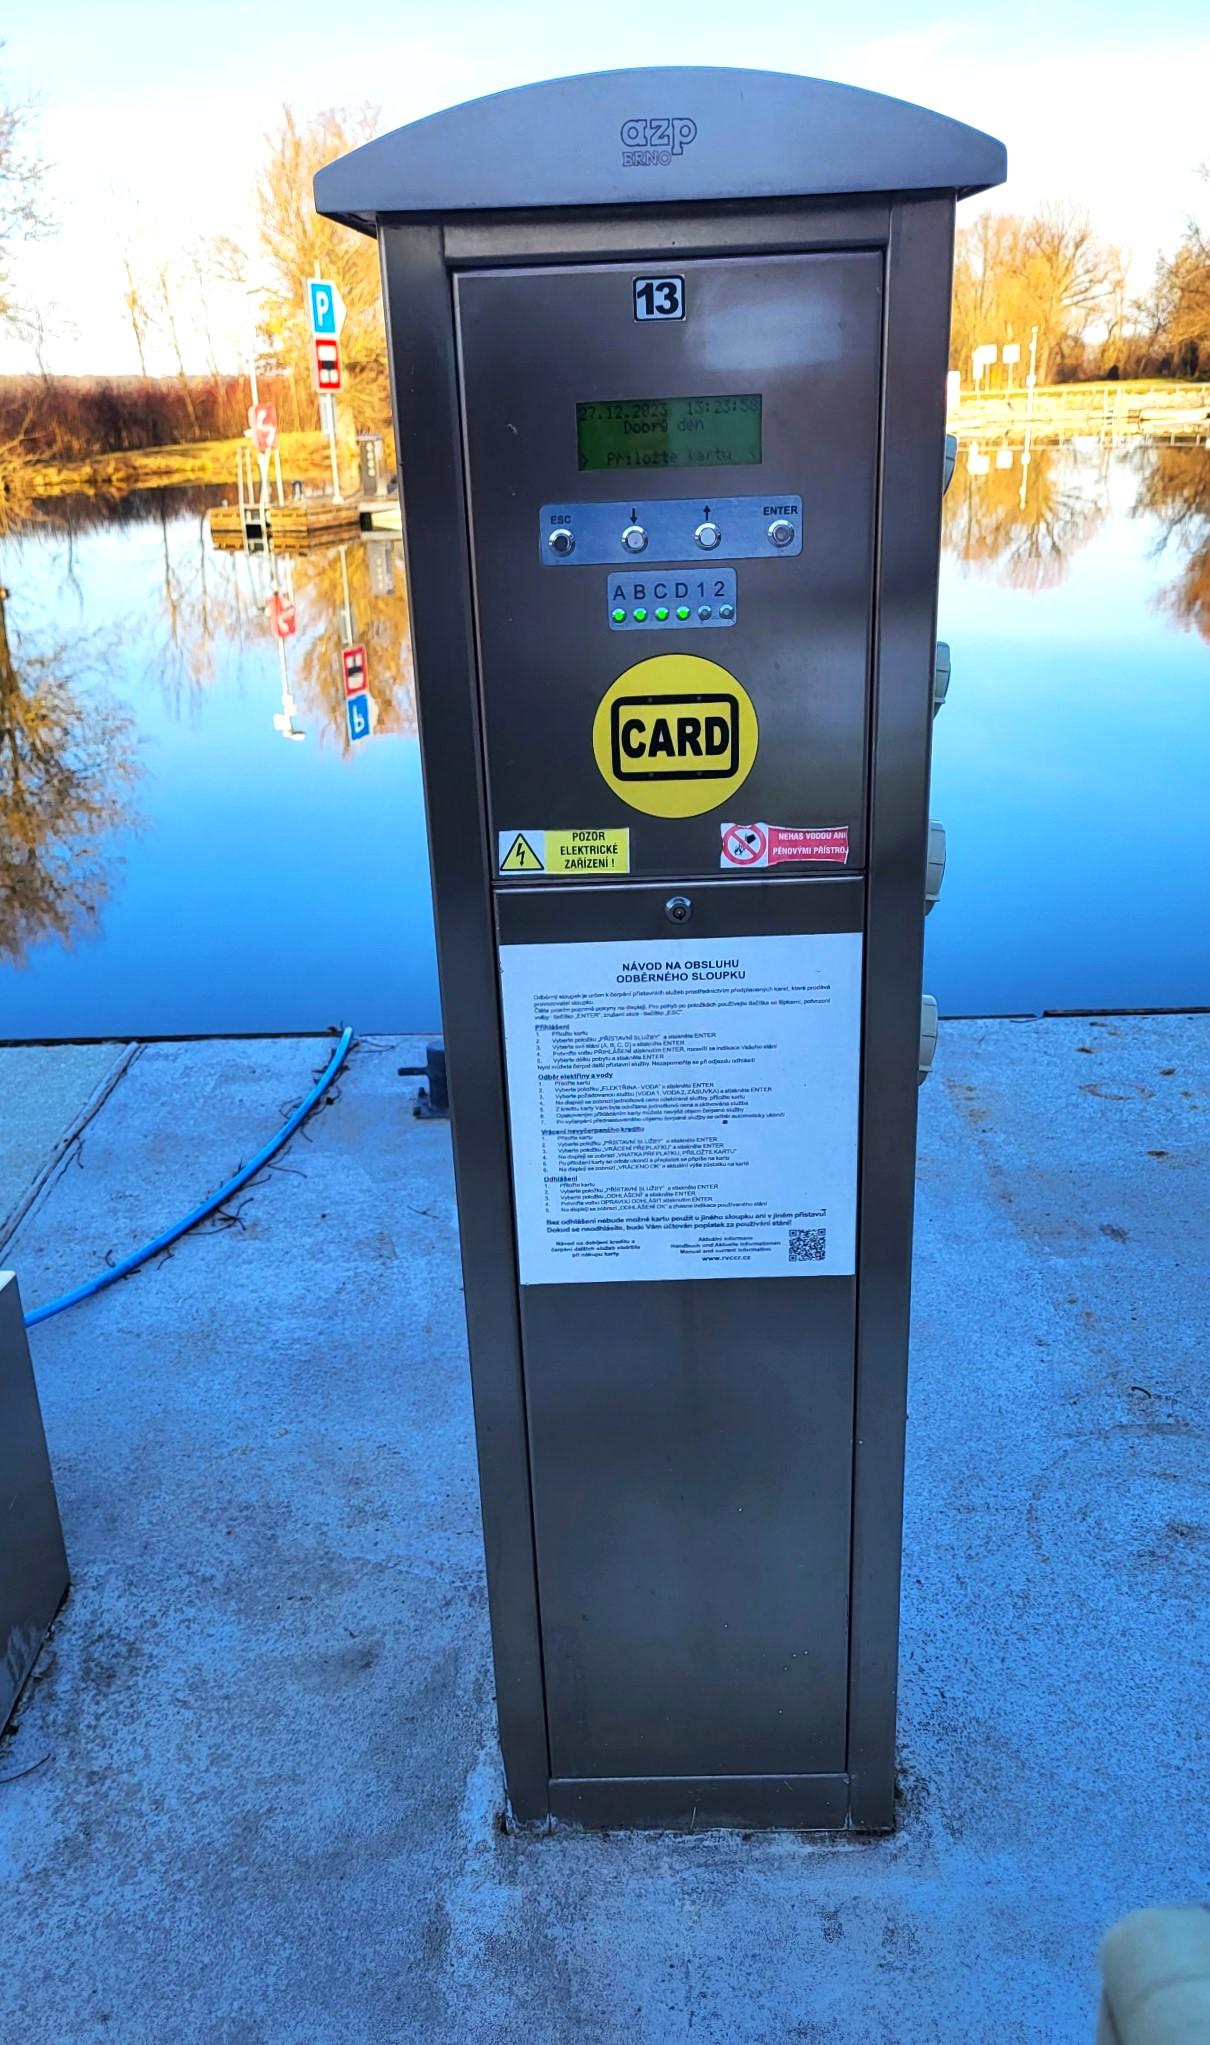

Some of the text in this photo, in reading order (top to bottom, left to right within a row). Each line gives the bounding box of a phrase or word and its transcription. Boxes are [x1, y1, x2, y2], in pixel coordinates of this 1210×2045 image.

[620, 117, 698, 155] azp
[622, 150, 672, 167] BRNO
[636, 281, 680, 316] 13
[315, 291, 330, 327] P
[676, 416, 705, 432] den
[550, 506, 798, 525] ESC ENTER
[613, 581, 725, 601] A B C D 1 2
[621, 716, 730, 759] CARD
[572, 831, 605, 842] POZOR
[805, 831, 832, 840] VODOU
[560, 843, 619, 856] ELEKTRICKÉ
[564, 855, 608, 869] ZAŘÍZENÍ
[622, 959, 739, 971] NÁVOD NA OBSLUHU
[616, 971, 746, 983] ODBĚRNÉHO SLOUPKU
[559, 1072, 590, 1081] elektřiny
[596, 1072, 613, 1080] vody
